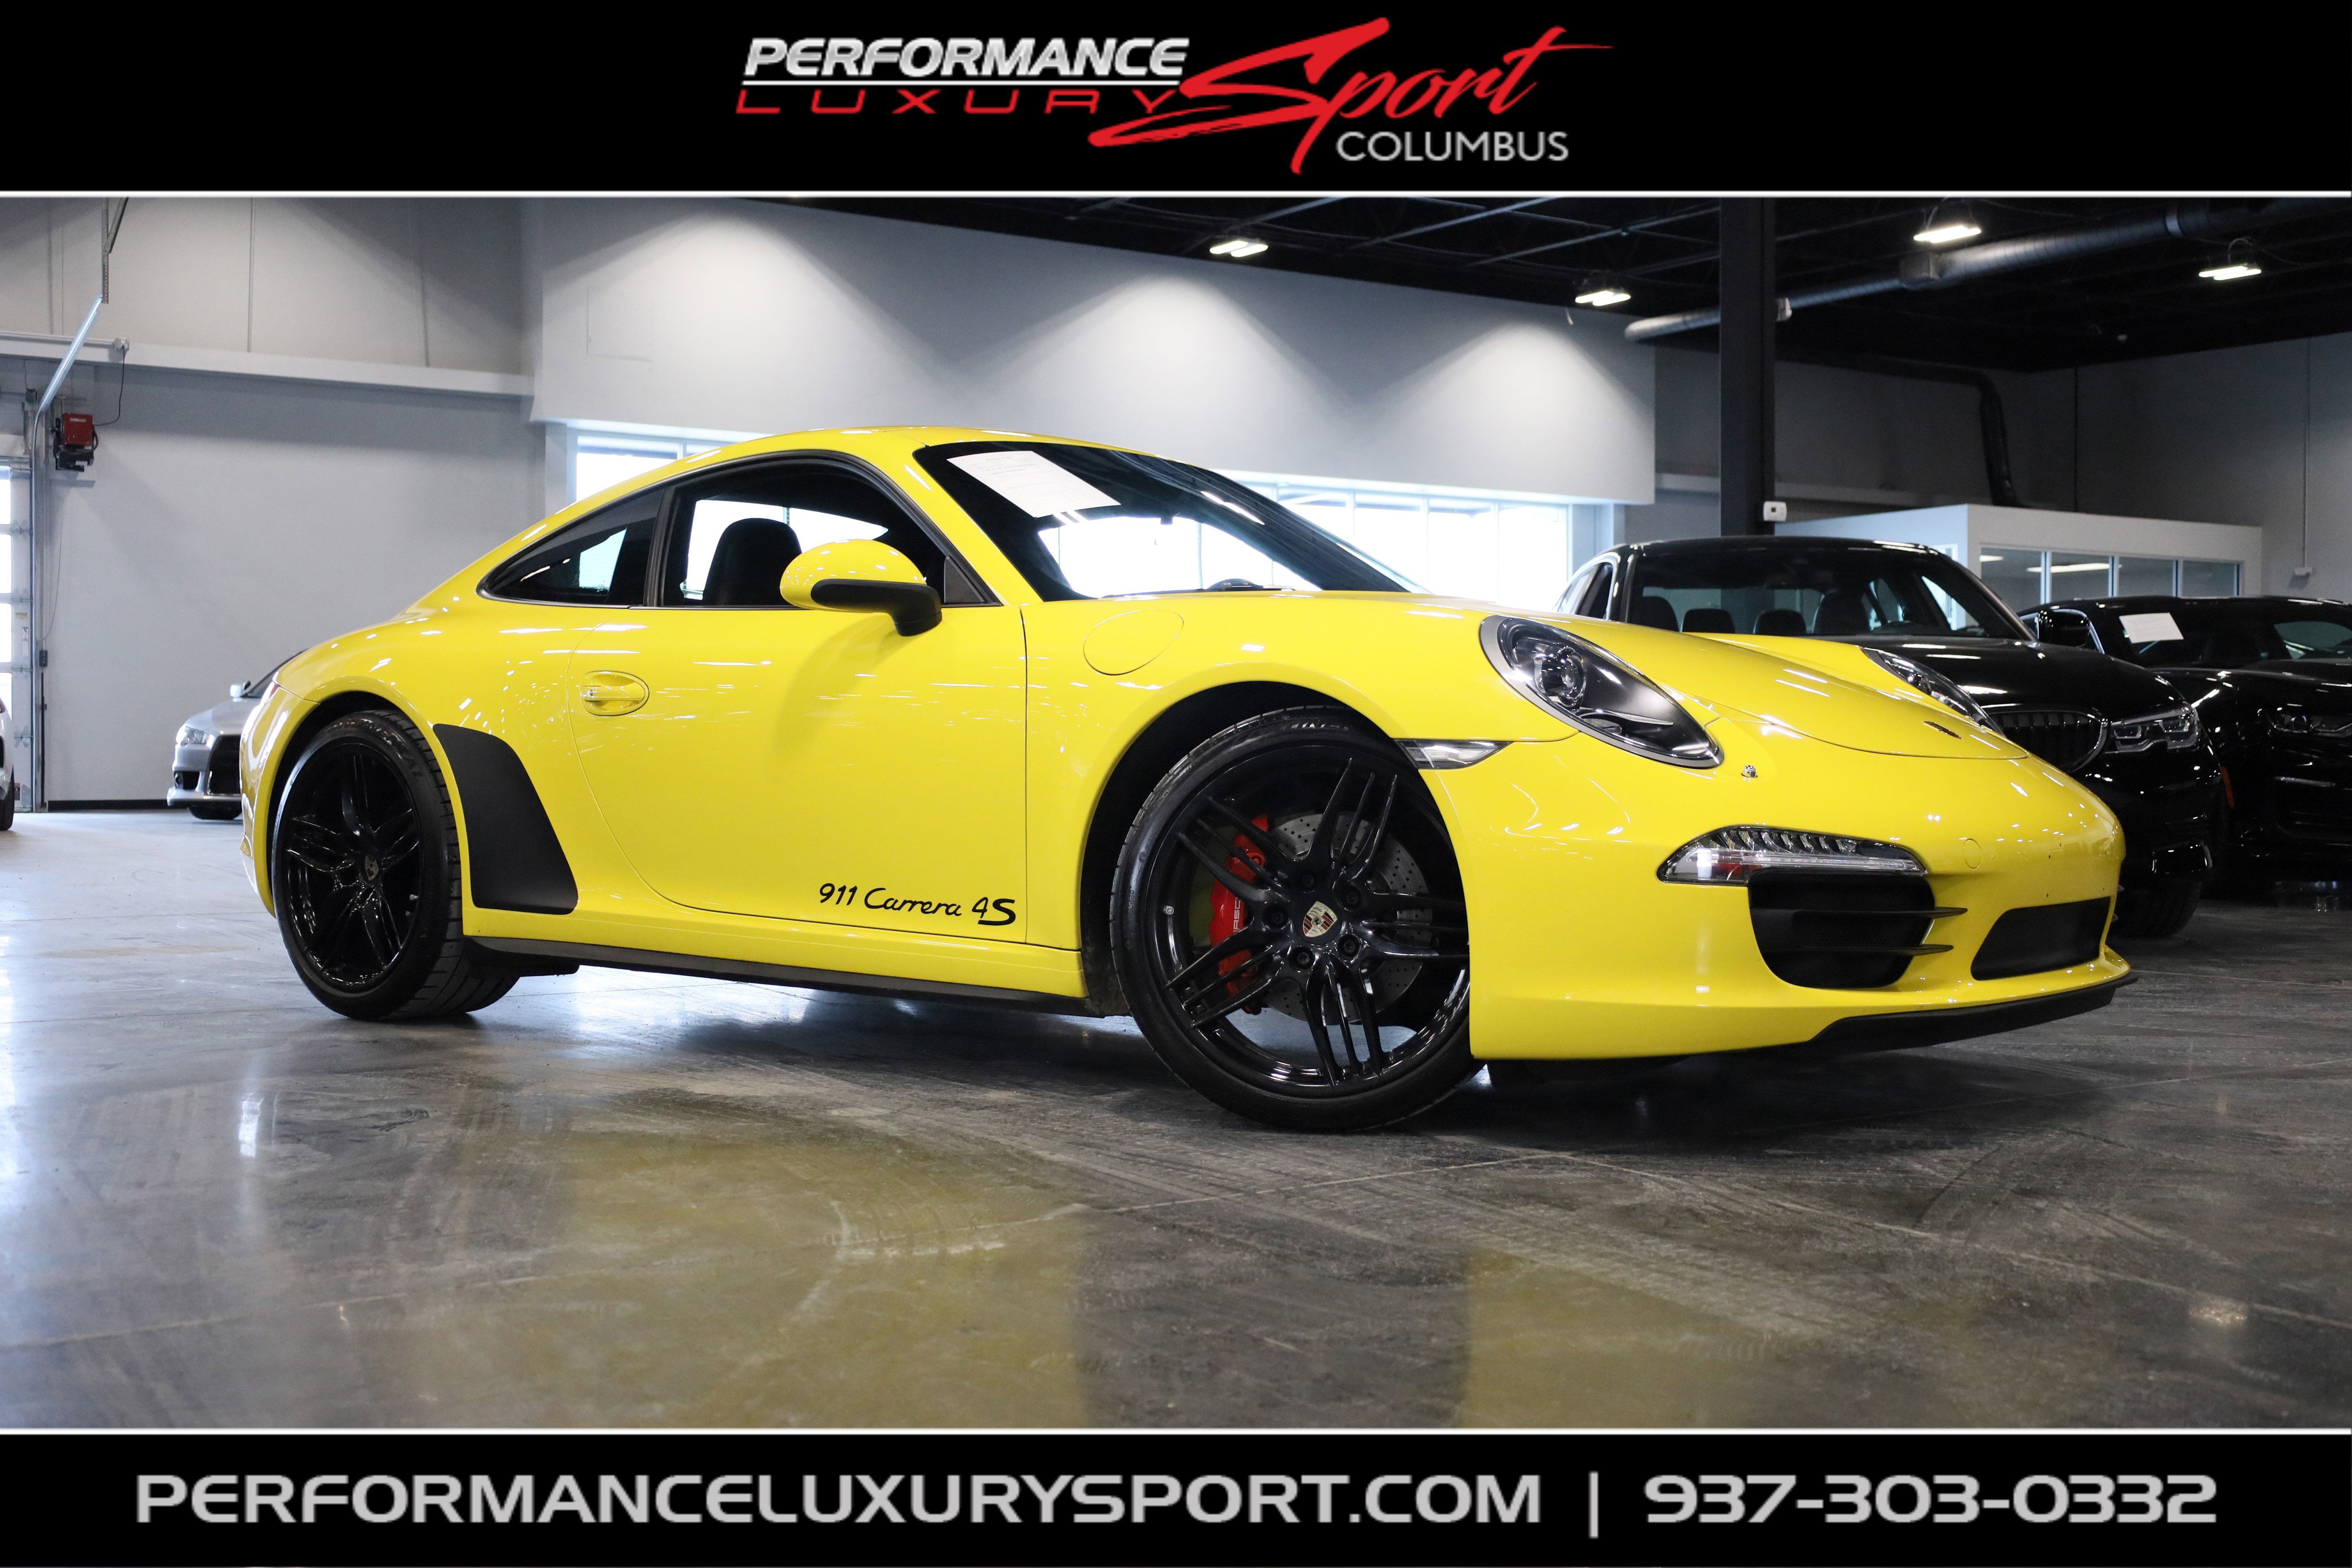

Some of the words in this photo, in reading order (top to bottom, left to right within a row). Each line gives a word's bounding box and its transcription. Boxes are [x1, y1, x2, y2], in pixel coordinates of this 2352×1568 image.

[820, 883, 858, 905] 911
[864, 888, 962, 916] Carrera
[971, 897, 1016, 926] 4S
